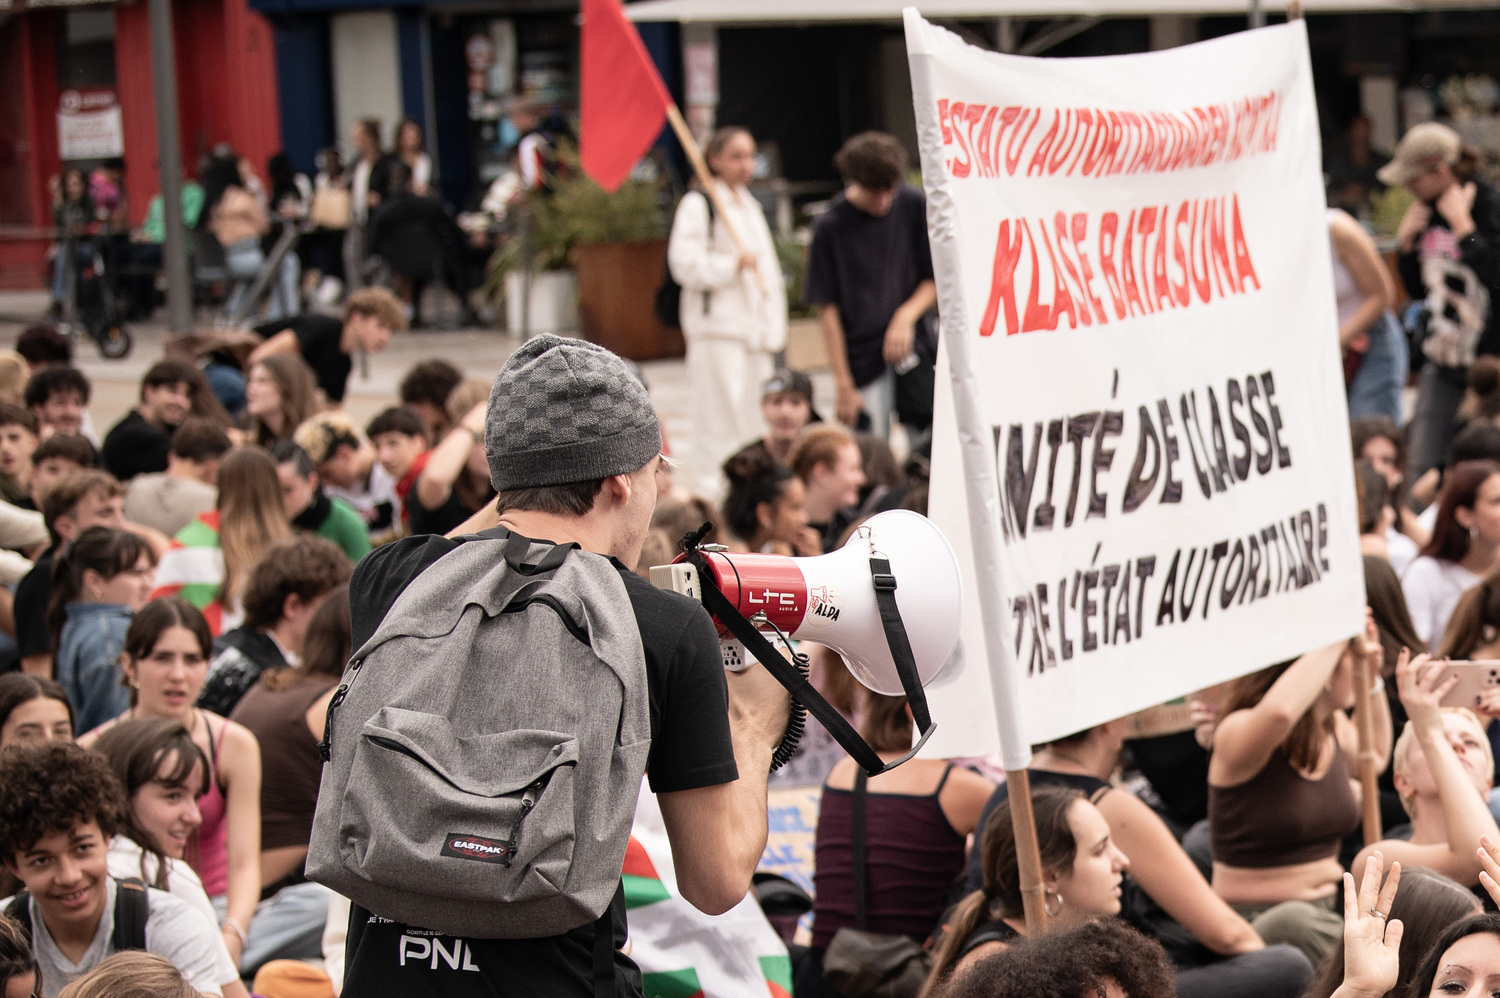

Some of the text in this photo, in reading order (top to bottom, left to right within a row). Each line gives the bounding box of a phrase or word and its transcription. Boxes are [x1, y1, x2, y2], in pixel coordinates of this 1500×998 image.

[937, 98, 1041, 178] ESTATU
[979, 191, 1262, 337] KLASE BATASUNA
[1122, 397, 1183, 514] DE
[1179, 369, 1292, 500] CLASSE
[814, 602, 840, 622] ALDA
[1008, 502, 1330, 679] TRE L'ÉTAT AUTORITAIRE
[453, 840, 502, 854] EASTPAK
[400, 934, 480, 972] PNL
